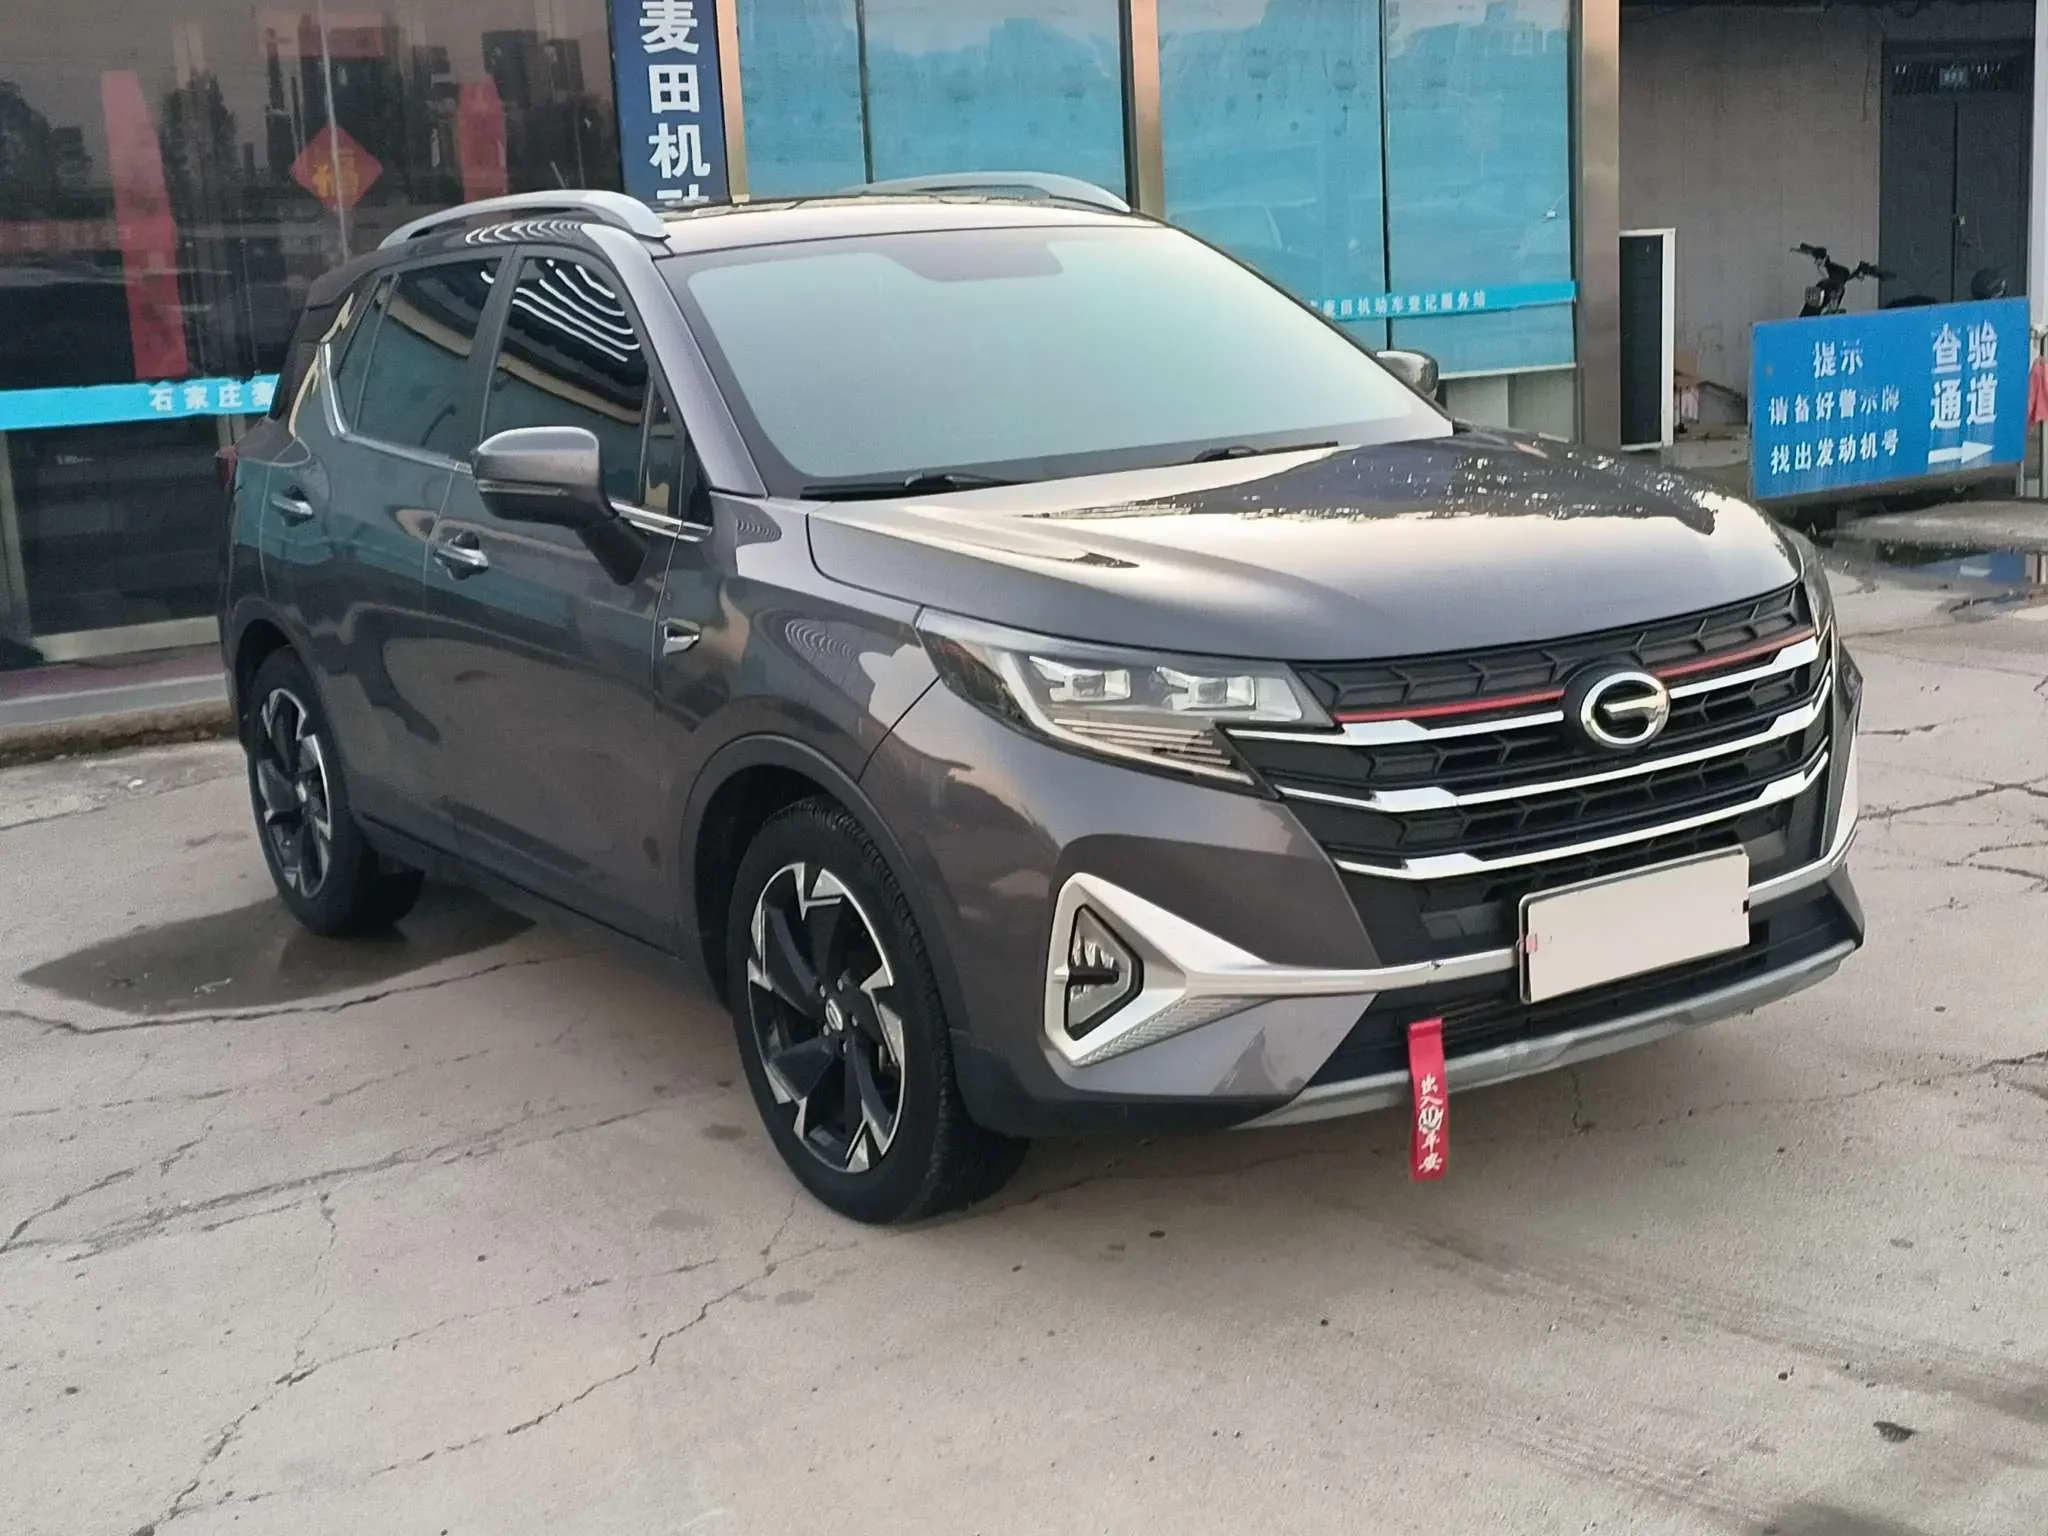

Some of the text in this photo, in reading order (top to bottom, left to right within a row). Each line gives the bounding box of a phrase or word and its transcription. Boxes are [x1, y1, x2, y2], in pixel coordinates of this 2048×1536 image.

[1812, 338, 1863, 378] 提示
[1931, 320, 1998, 374] 查验
[1930, 373, 1998, 430] 通道
[1770, 428, 1899, 475] 找出发动机号
